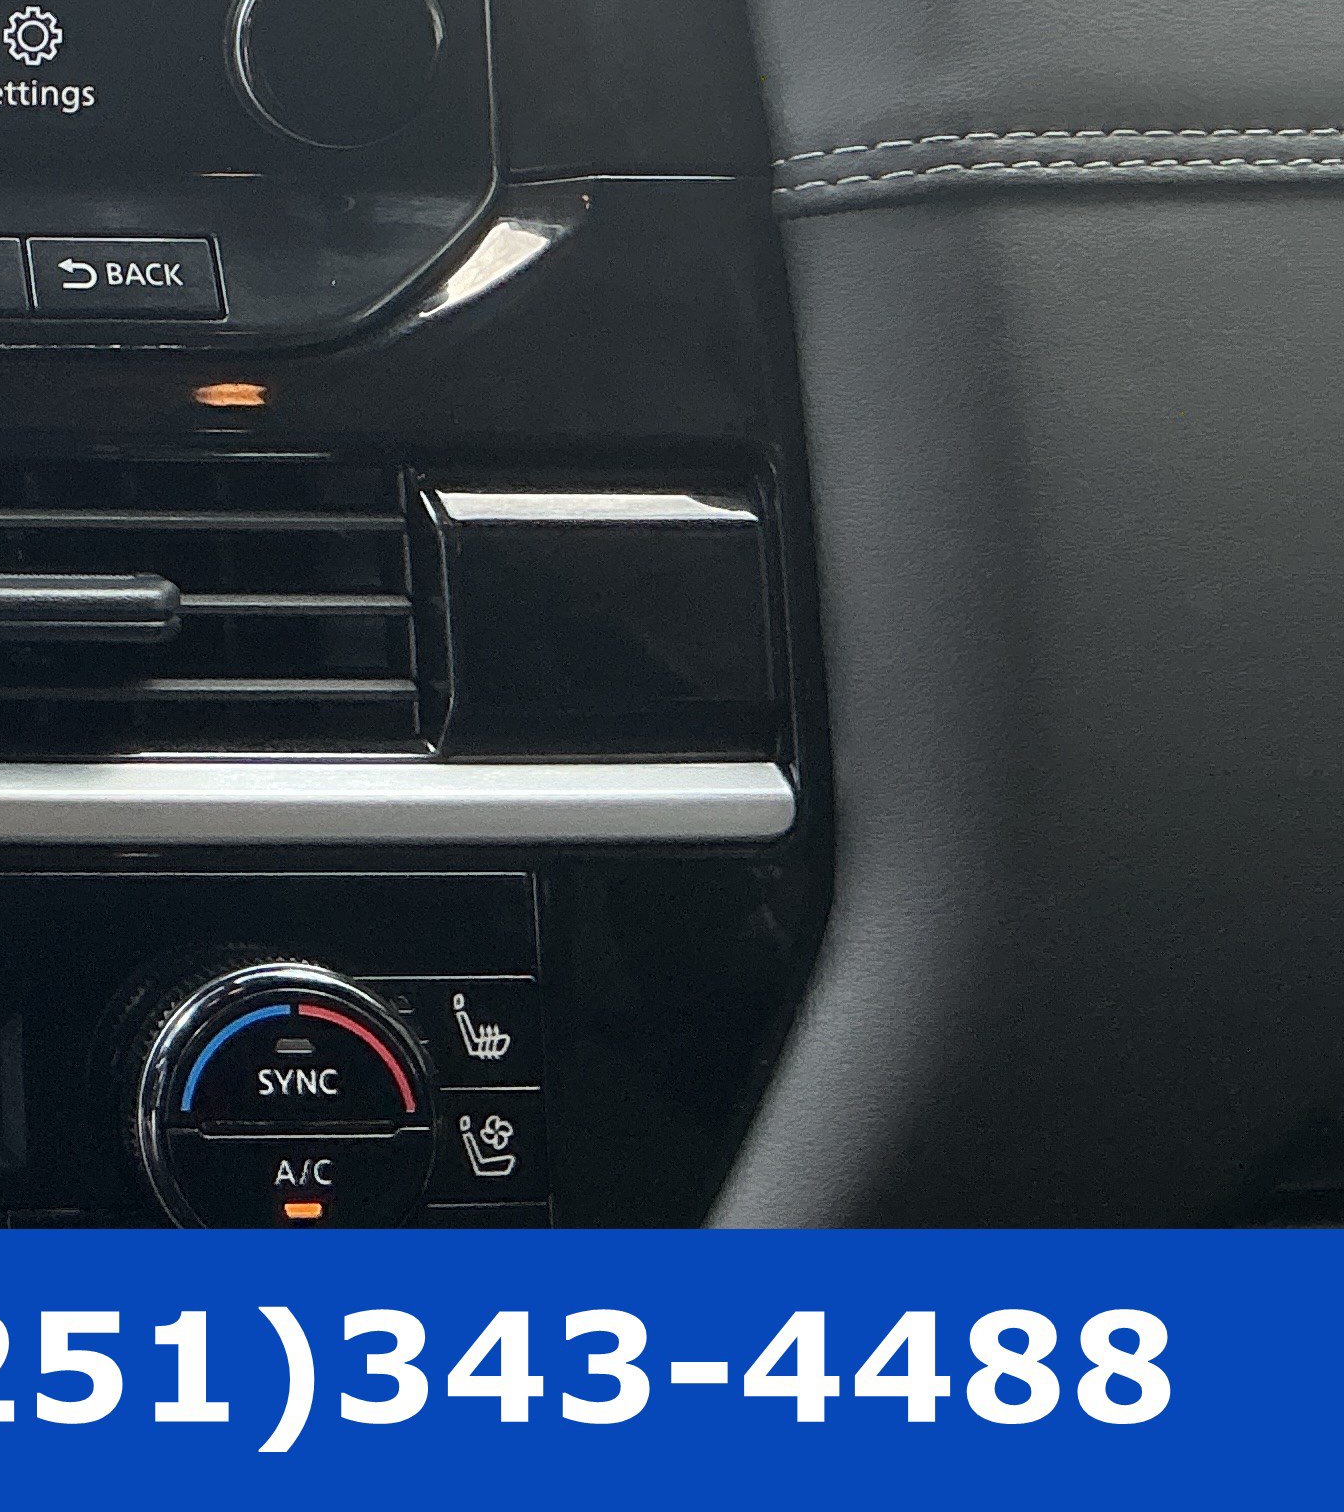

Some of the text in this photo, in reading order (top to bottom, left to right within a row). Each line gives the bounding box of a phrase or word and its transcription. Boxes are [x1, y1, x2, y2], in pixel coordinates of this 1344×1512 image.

[105, 261, 185, 288] BACK
[256, 1068, 340, 1097] SYNC
[273, 1159, 334, 1188] A/C
